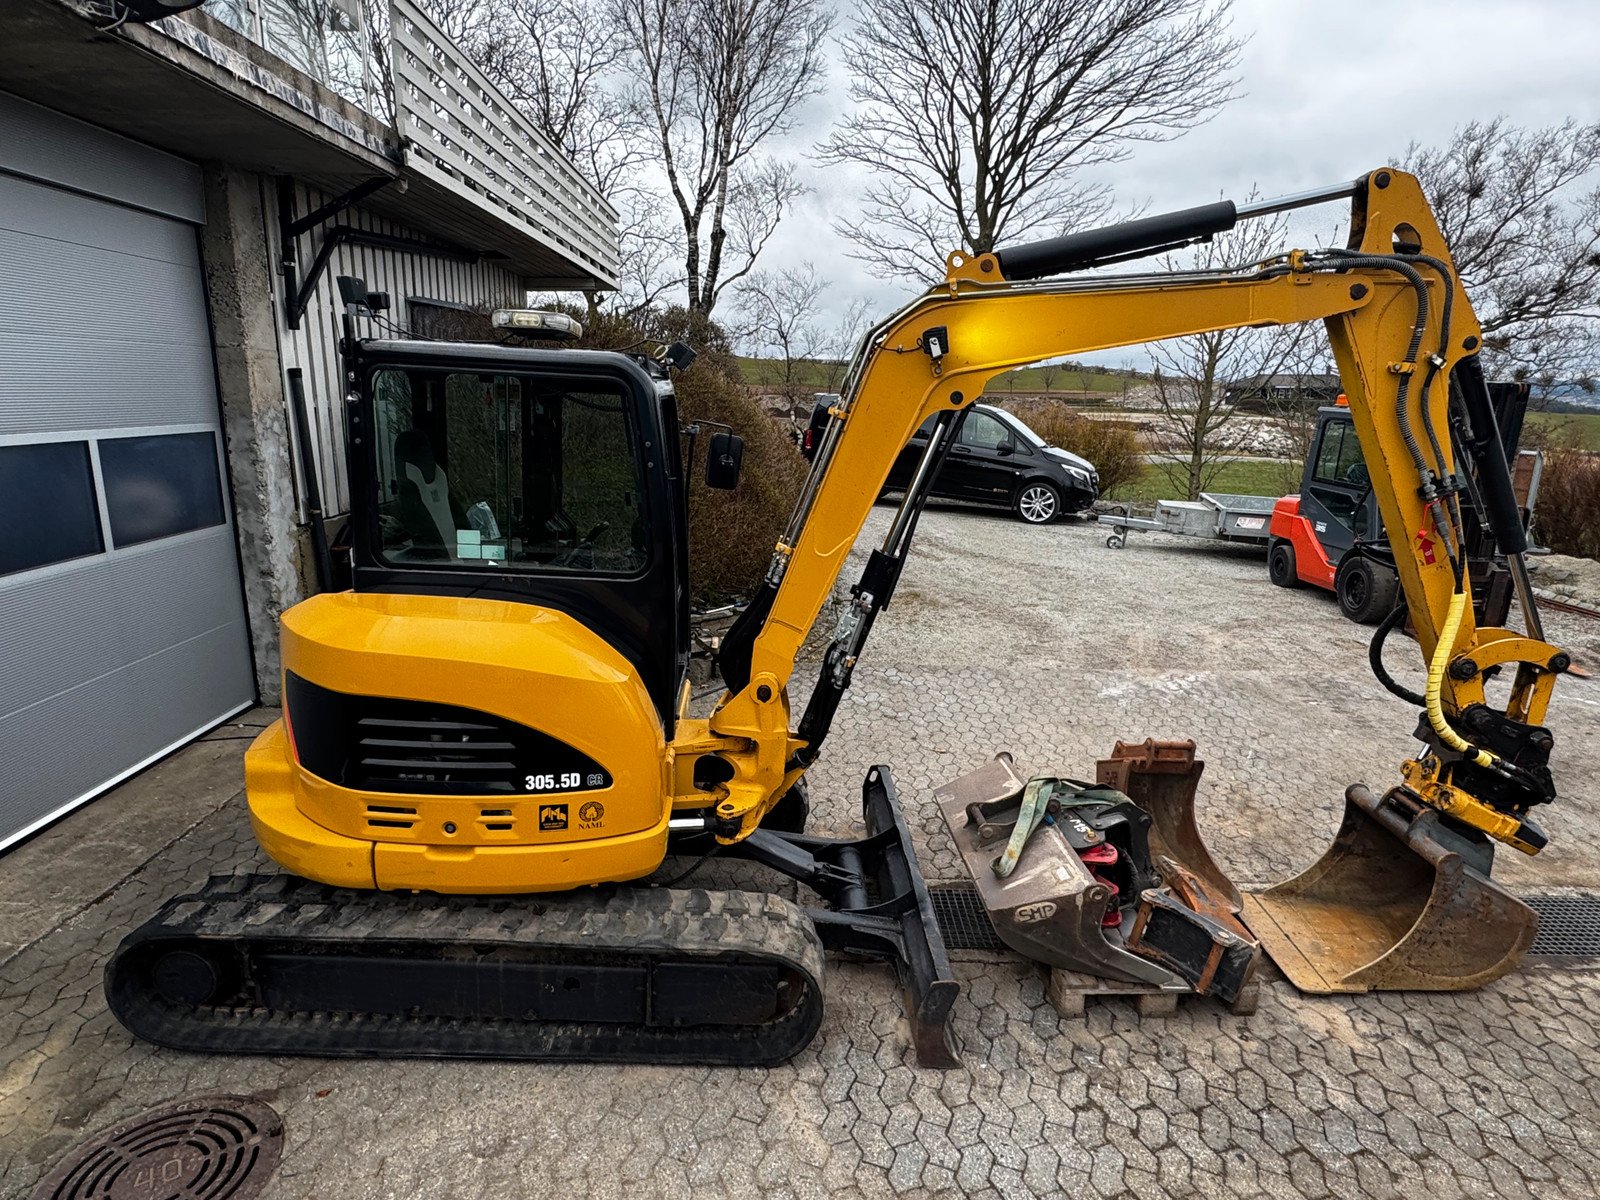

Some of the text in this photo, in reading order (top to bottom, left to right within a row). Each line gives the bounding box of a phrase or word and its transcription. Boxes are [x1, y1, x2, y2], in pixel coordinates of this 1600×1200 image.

[525, 773, 604, 790] 305.5D CR
[1019, 905, 1054, 921] SMP
[134, 1159, 182, 1190] 40
